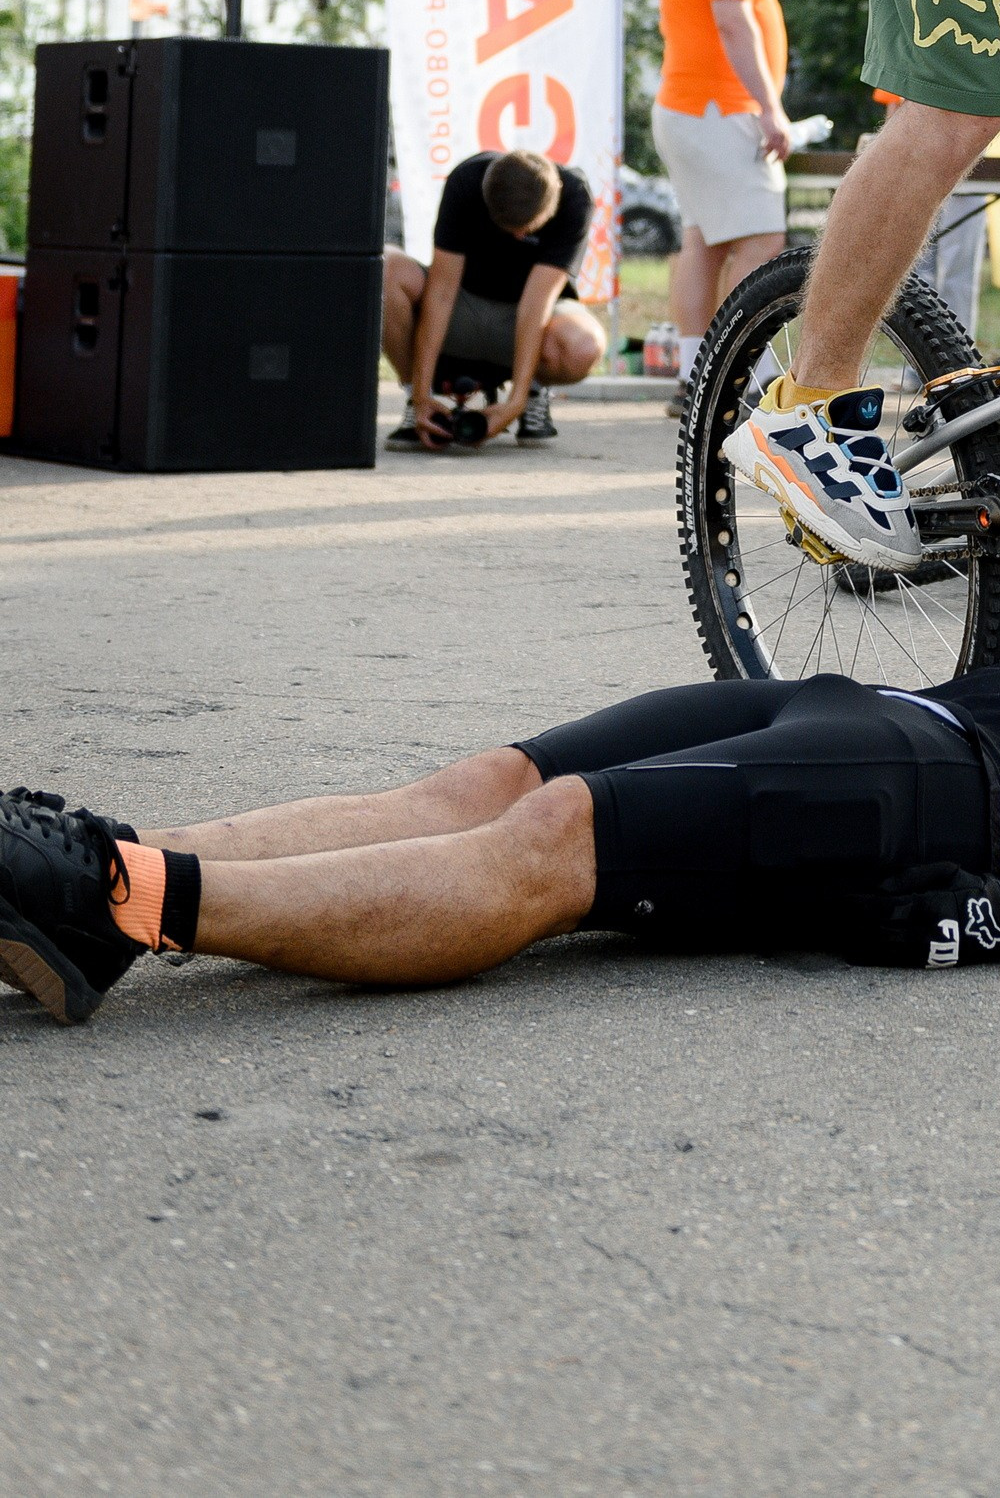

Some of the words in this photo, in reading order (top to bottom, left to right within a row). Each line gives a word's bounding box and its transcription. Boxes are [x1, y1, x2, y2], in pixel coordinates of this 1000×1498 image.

[713, 308, 744, 355] ENDURO
[688, 379, 708, 439] ROCK
[684, 444, 695, 530] MICHELIN
[926, 919, 960, 969] FO
